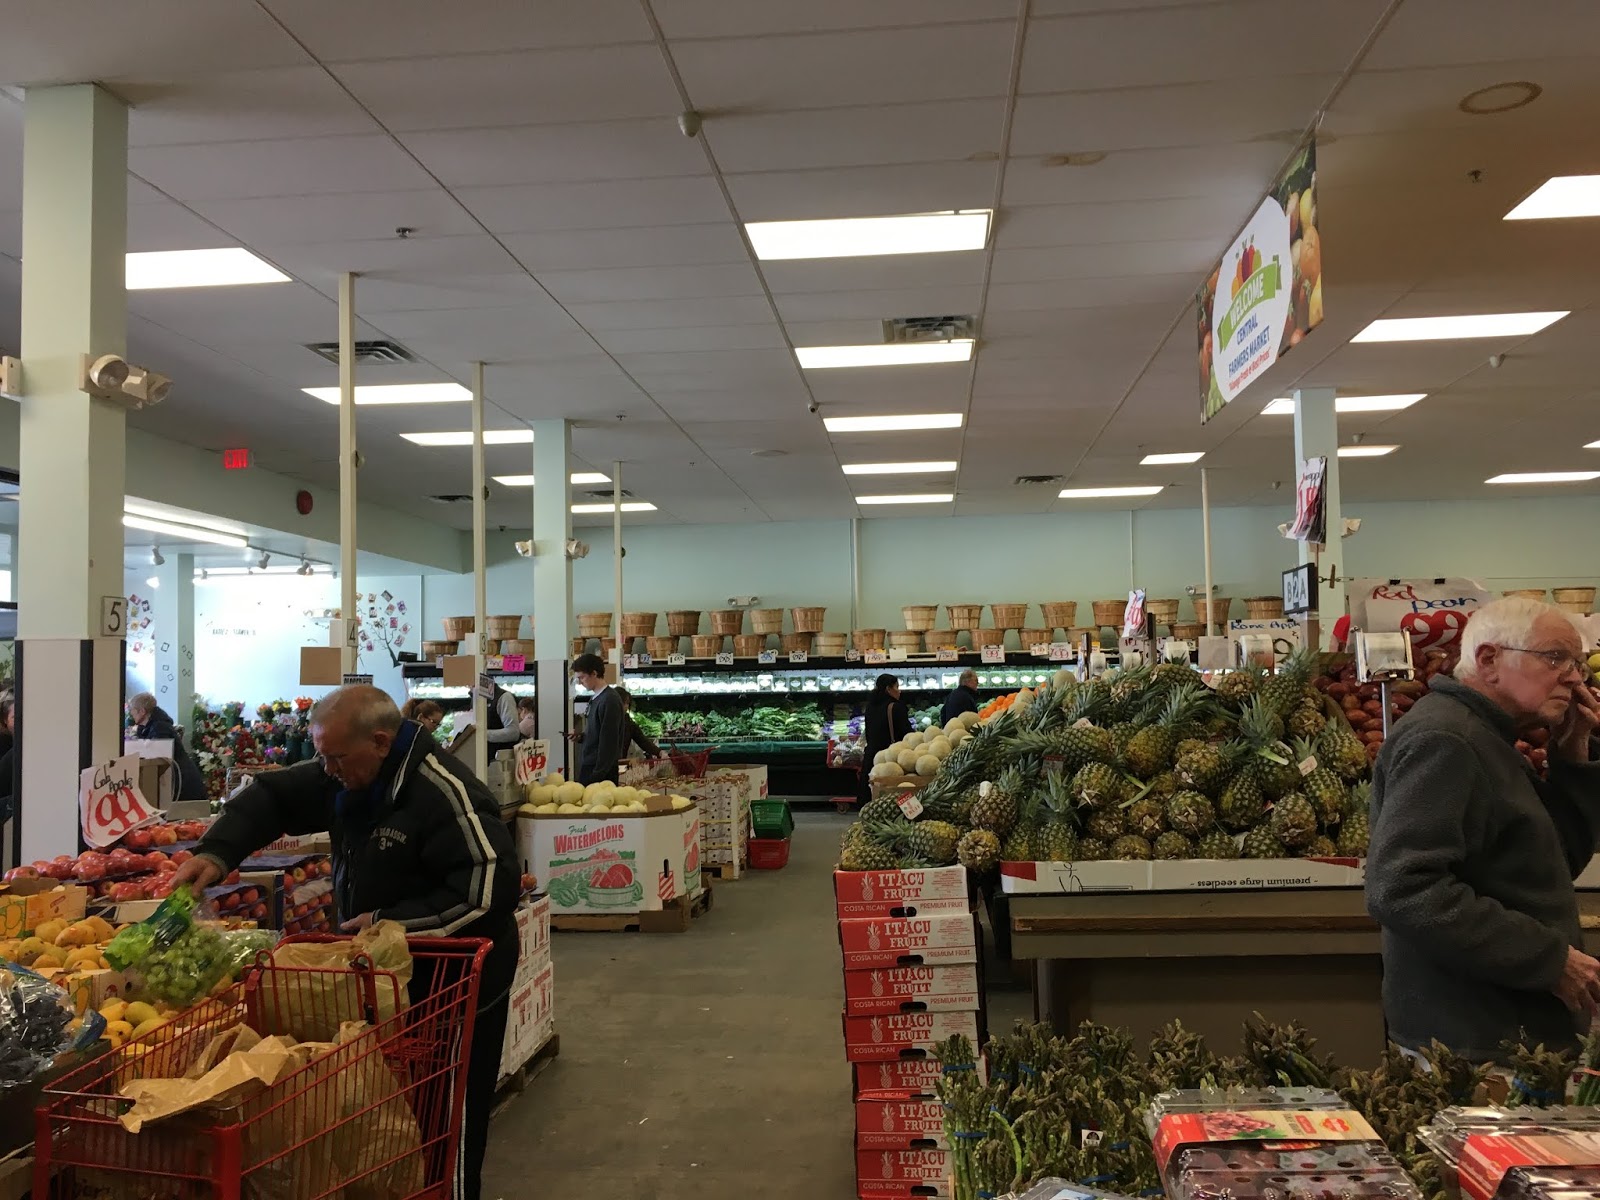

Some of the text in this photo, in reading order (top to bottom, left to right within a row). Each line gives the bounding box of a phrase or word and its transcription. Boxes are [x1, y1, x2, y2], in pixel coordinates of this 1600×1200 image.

[1229, 272, 1264, 329] WELCOME
[1237, 313, 1258, 345] CENTRAL
[1229, 325, 1270, 377] FARMERS MARKET
[224, 449, 248, 469] EXIT
[1373, 585, 1418, 600] Red
[1411, 597, 1477, 614] pear
[108, 601, 122, 632] 5
[348, 621, 357, 643] 4
[1231, 621, 1265, 630] Rome
[568, 824, 587, 835] Fresh
[554, 824, 624, 855] WATERMELONS
[878, 873, 924, 887] ITACU
[1197, 876, 1311, 889] premium large seedless
[884, 888, 921, 899] FRUIT
[884, 921, 931, 936] ITACU
[890, 936, 928, 948] FRUIT
[887, 967, 934, 982] ITACU
[893, 983, 932, 994] FRUIT
[887, 1014, 933, 1029] ITACU
[893, 1030, 931, 1041] FRUIT
[904, 1119, 943, 1131] FRUIT
[899, 1151, 945, 1165] ITACU
[903, 1167, 942, 1178] FRUIT
